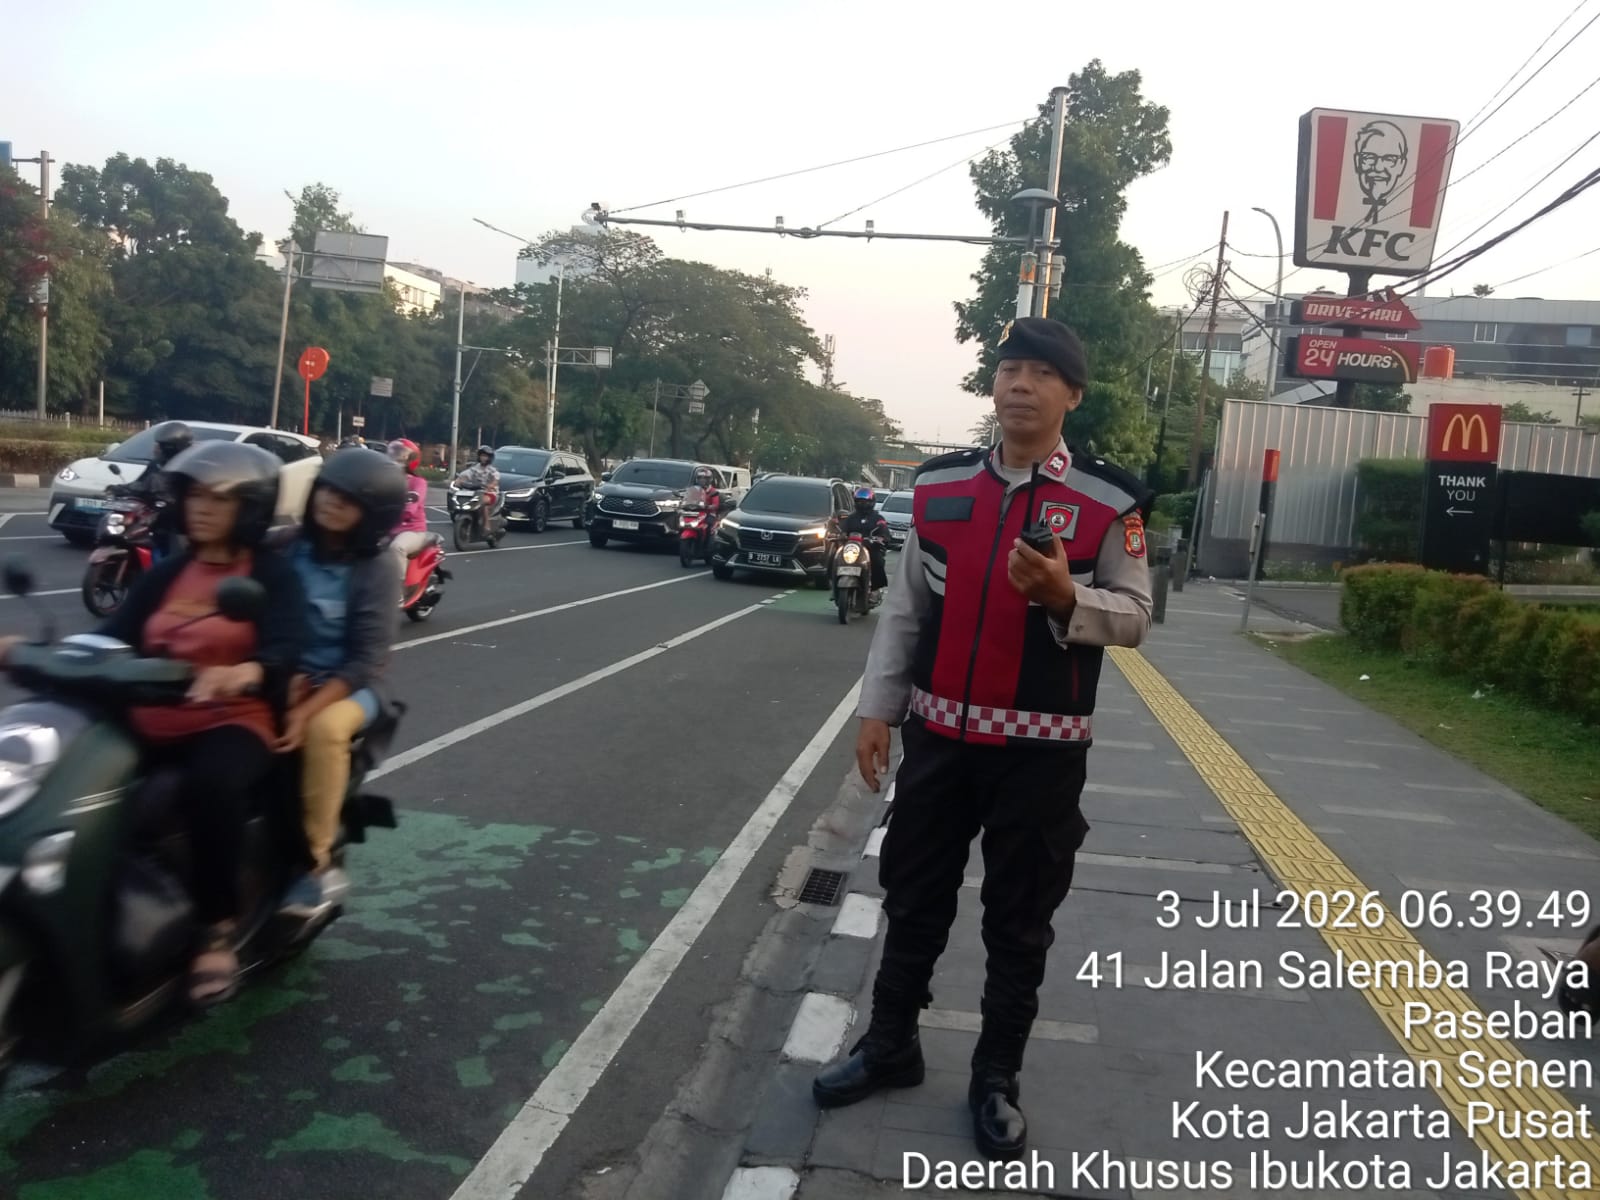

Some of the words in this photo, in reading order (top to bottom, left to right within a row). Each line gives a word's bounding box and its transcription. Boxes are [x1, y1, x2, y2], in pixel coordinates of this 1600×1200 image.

[1323, 225, 1416, 262] KFC
[1305, 303, 1403, 322] DRIVE-THRU
[1309, 339, 1338, 349] OPEN
[1304, 348, 1335, 367] 24
[1337, 352, 1393, 368] HOURS
[1438, 474, 1487, 488] THANK
[1447, 489, 1476, 501] YOU
